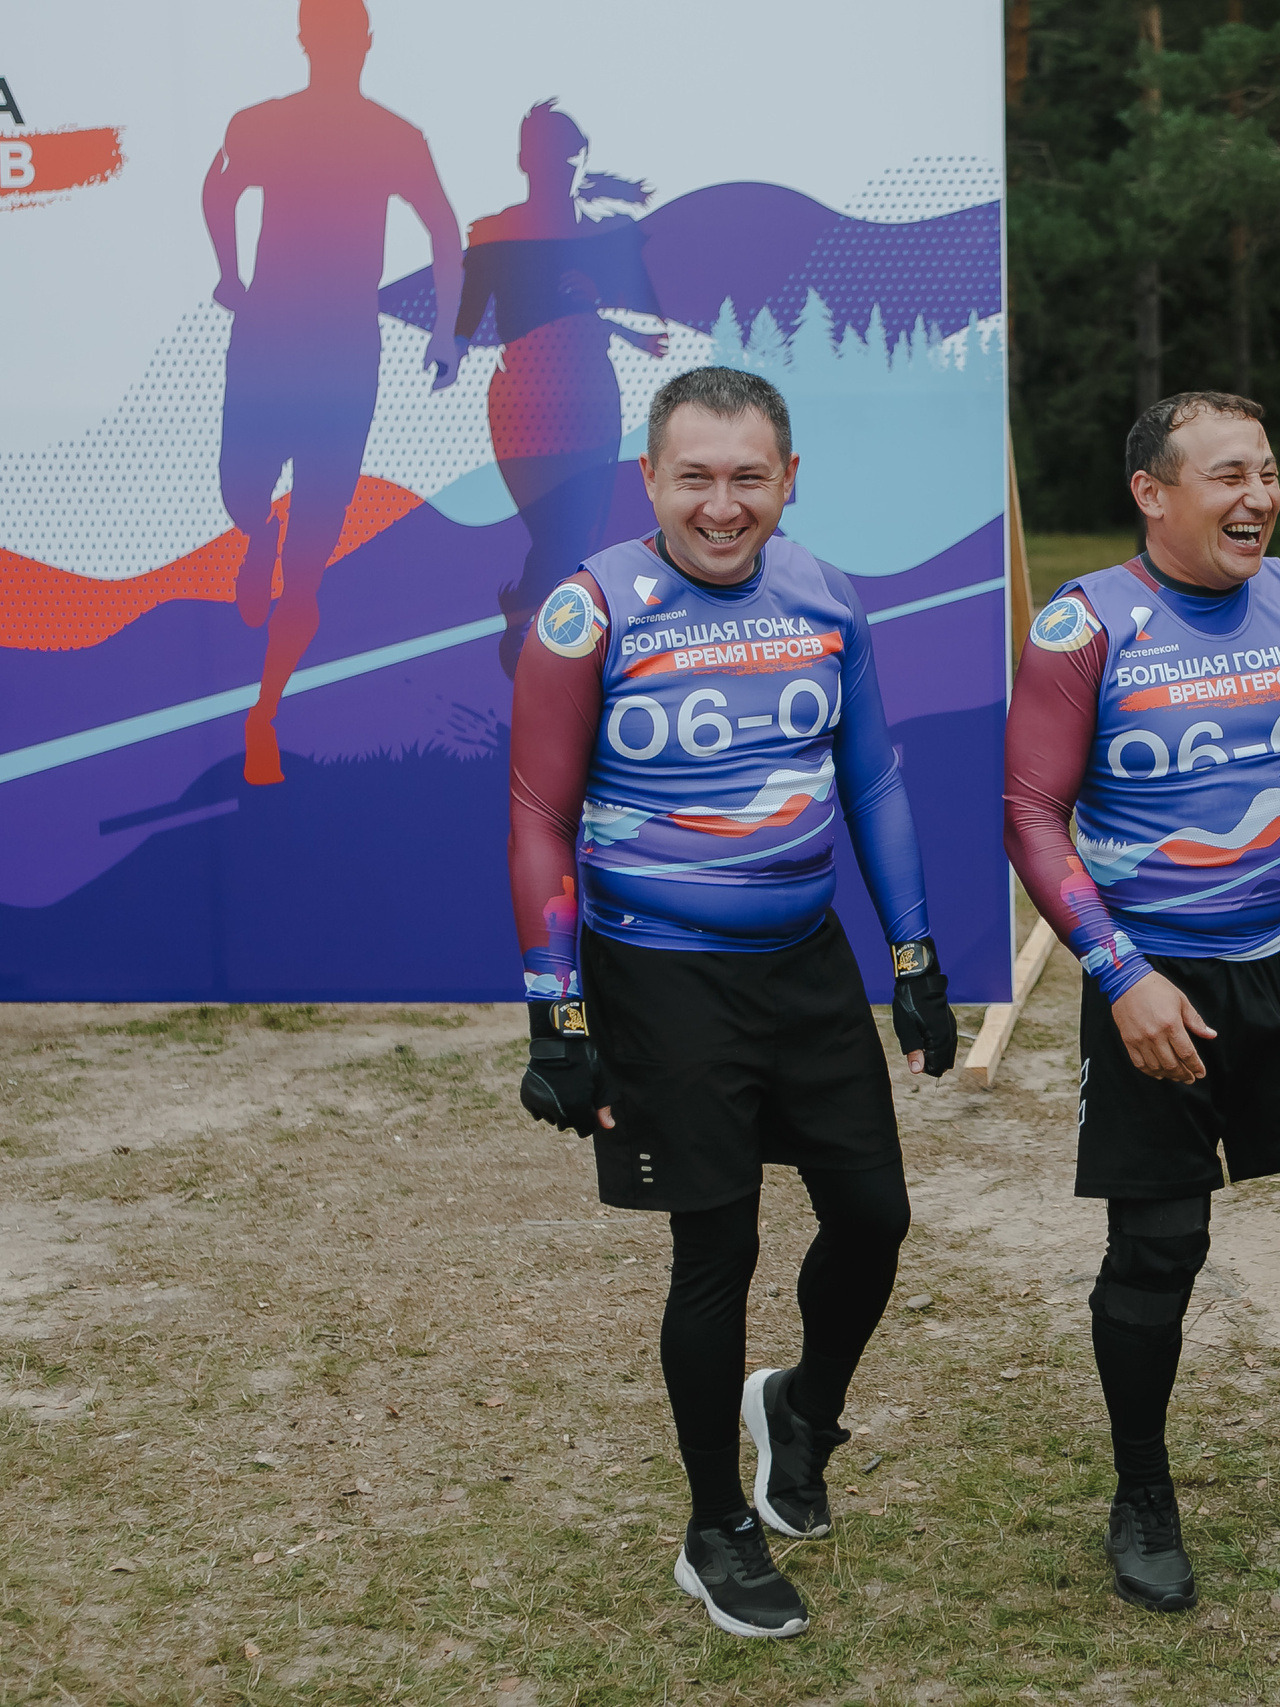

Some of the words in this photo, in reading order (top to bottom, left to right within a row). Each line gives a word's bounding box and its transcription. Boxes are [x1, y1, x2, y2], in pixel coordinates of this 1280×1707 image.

[628, 609, 687, 627] Ростелеком
[621, 620, 740, 656] БОЛЬШАЯ
[743, 617, 814, 639] ГОНКА
[674, 645, 748, 669] ВРЕМЯ
[751, 638, 824, 661] ГЕРОЕВ
[1119, 643, 1180, 660] Ростелеком
[1116, 654, 1230, 688] БОЛЬШАЯ
[1168, 678, 1238, 704] ВРЕМЯ
